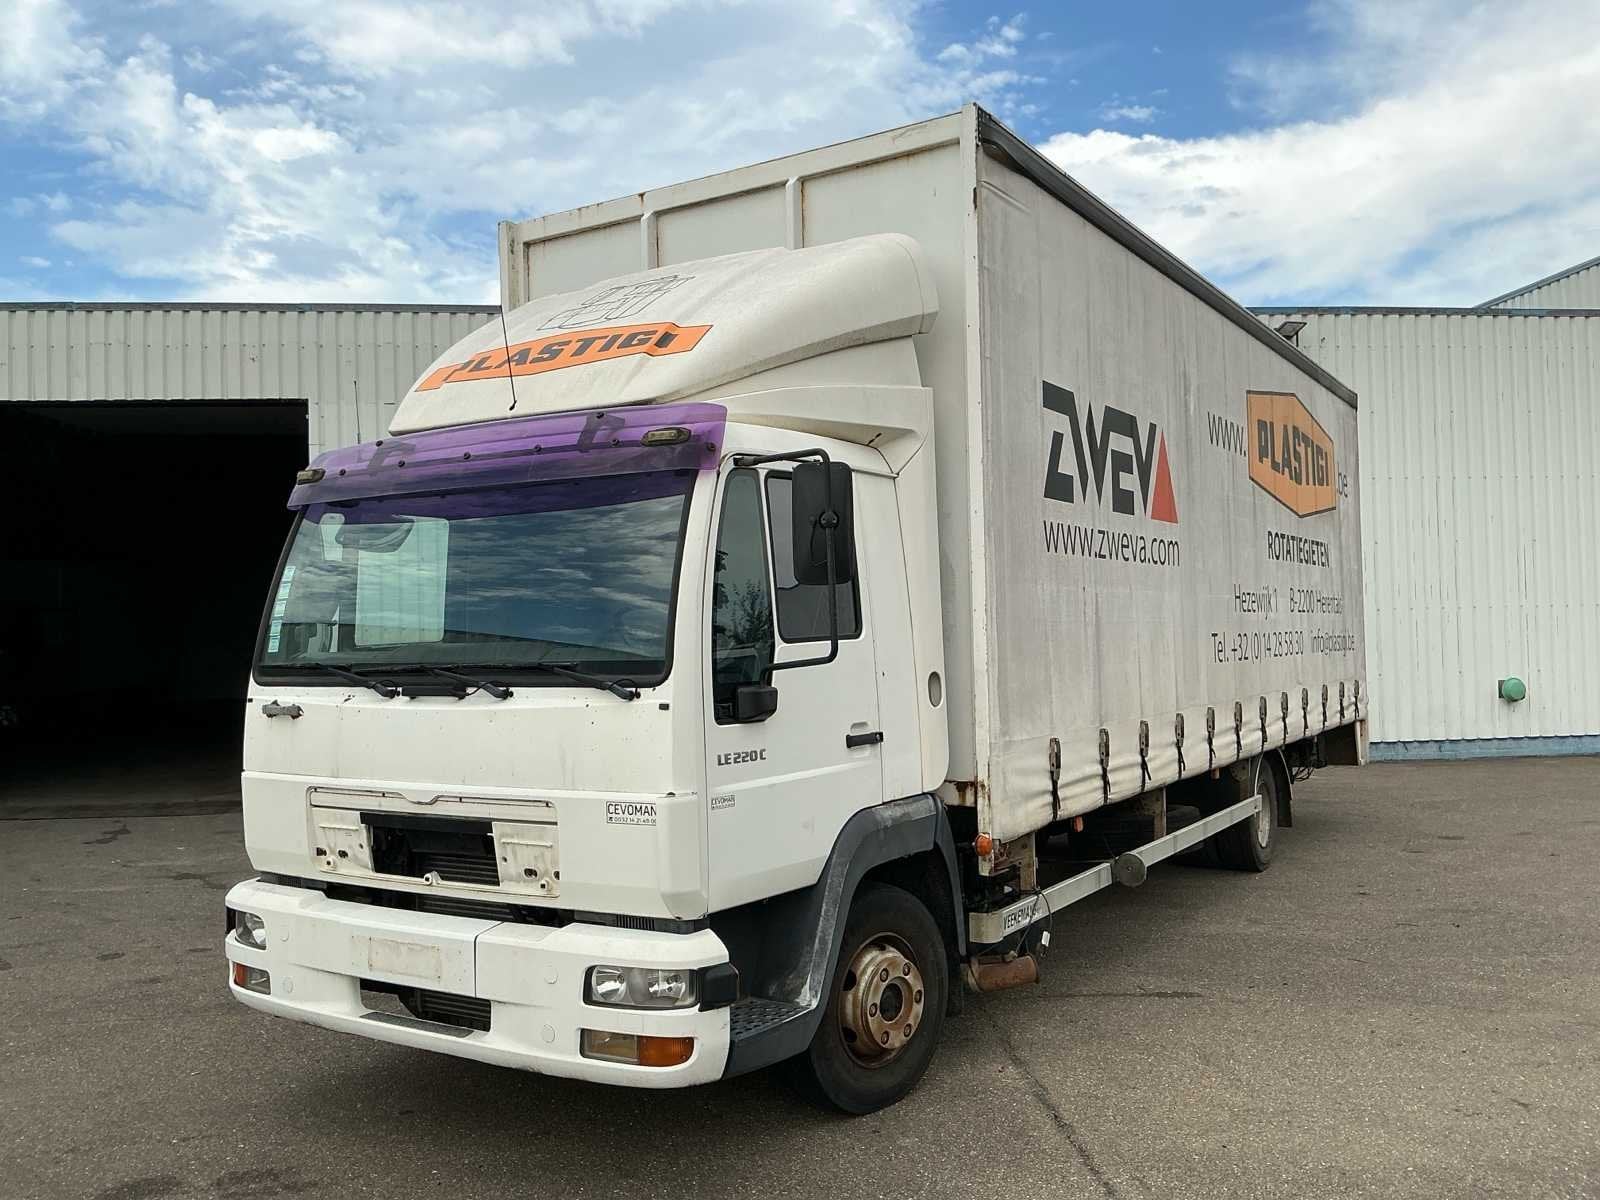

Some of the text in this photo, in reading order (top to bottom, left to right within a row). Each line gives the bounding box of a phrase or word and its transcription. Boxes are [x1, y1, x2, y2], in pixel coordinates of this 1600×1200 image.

[1207, 411, 1247, 457] www.
[1257, 418, 1330, 487] PLASTIGI
[1043, 519, 1180, 567] www.zweva.com
[1267, 530, 1330, 569] ROTATIEGIETEN
[1233, 583, 1272, 621] Hezewijk
[1289, 587, 1315, 614] B-2200
[1211, 631, 1229, 664] Tel.
[1231, 632, 1249, 662] +32
[1250, 631, 1262, 665] (0)
[1263, 632, 1272, 659] 14
[1273, 631, 1283, 657] 28
